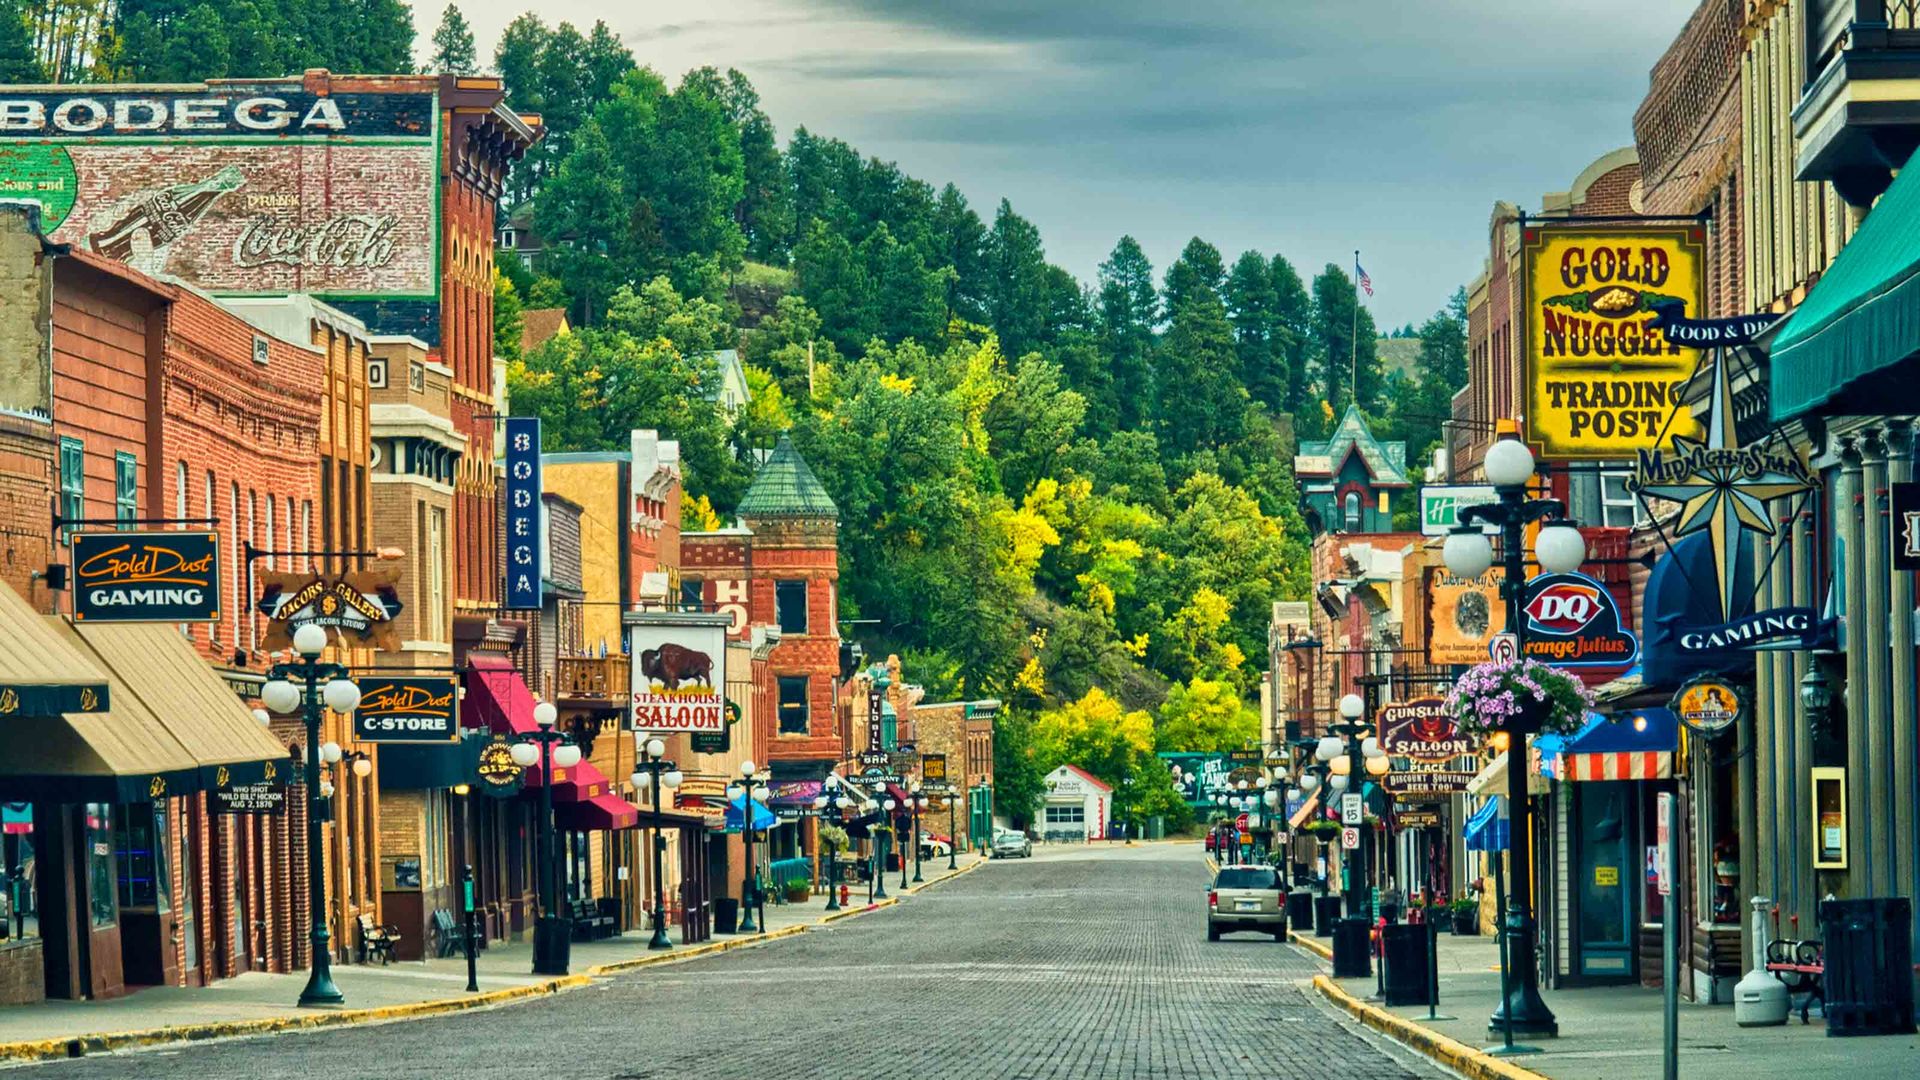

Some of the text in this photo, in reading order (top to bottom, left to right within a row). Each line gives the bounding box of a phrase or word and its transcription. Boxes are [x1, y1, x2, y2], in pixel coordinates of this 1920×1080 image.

[0, 98, 346, 132] BODEGA
[1560, 247, 1670, 288] GOLD
[1669, 324, 1719, 341] FOOD
[1724, 325, 1738, 339] &
[1570, 411, 1662, 439] POST
[514, 433, 532, 593] BODEGA
[79, 544, 213, 578] Gold Dust
[90, 589, 203, 606] GAMING
[279, 582, 382, 621] JACOBS GALLERY
[1540, 595, 1589, 623] DQ
[1681, 614, 1808, 649] GAMING
[1524, 639, 1577, 658] range
[359, 684, 453, 710] Gold Dust
[634, 693, 722, 704] STEAKHOUSE
[635, 706, 719, 728] SALOON
[1396, 741, 1467, 753] SALOON
[863, 754, 889, 764] BAR
[1204, 759, 1222, 773] GET
[1410, 763, 1446, 773] PLACE
[479, 765, 521, 775] GIFT
[849, 774, 900, 784] RESTAURANT
[1390, 775, 1427, 786] DISCOUNT
[1407, 783, 1429, 791] BEER
